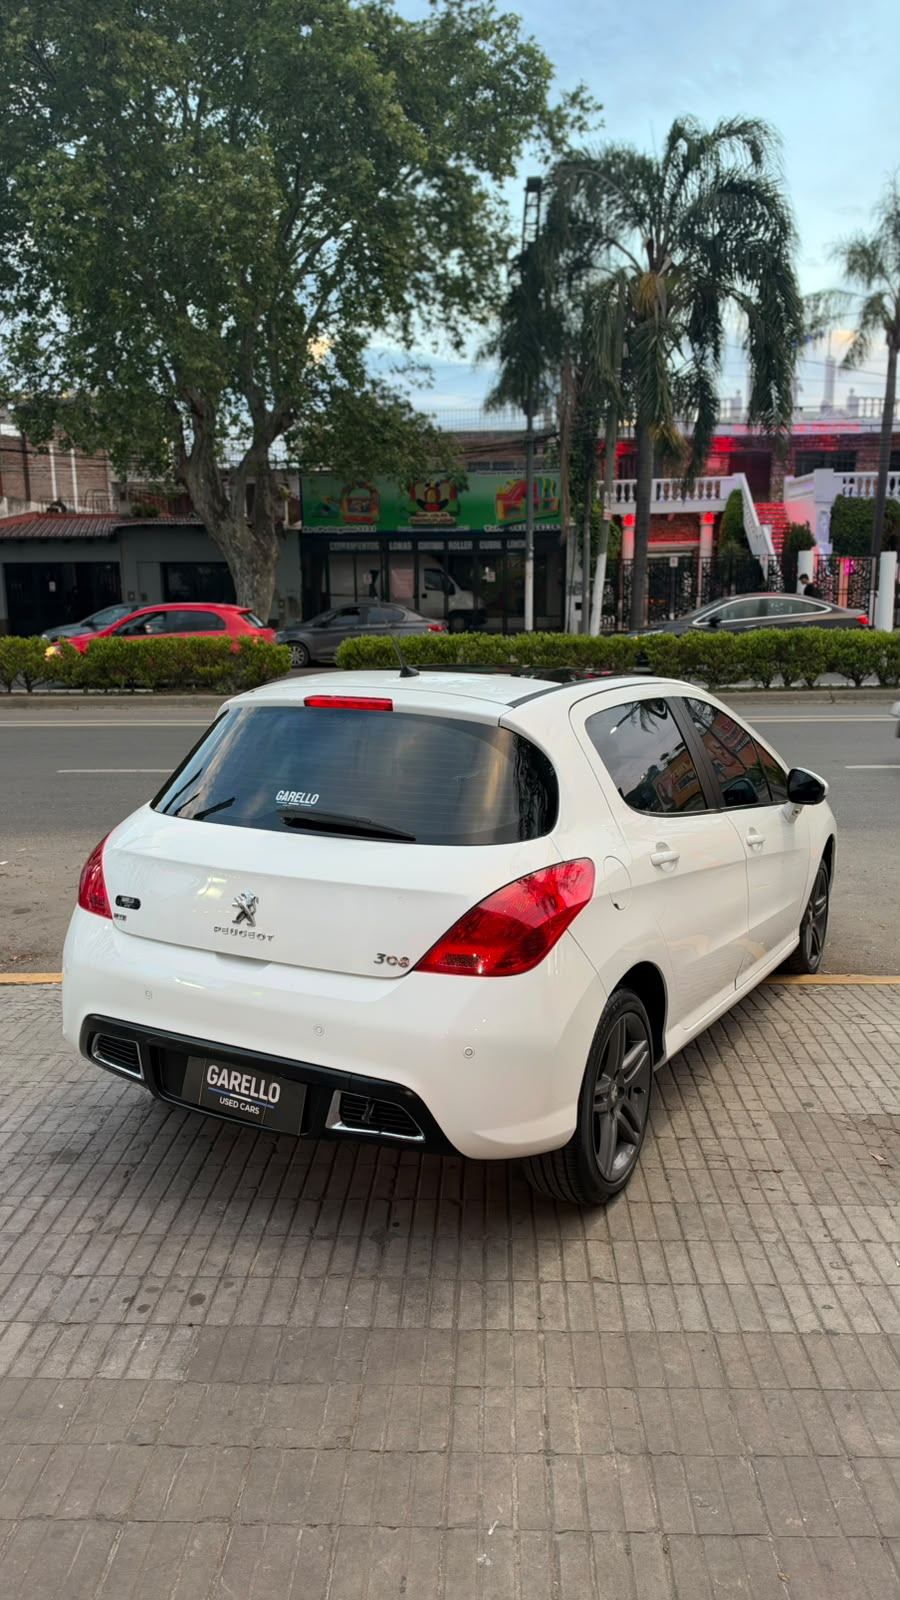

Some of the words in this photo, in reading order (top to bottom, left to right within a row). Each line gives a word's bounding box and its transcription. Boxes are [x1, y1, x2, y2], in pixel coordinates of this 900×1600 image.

[275, 790, 320, 805] GARELLO
[213, 926, 275, 942] PEUGEOT
[373, 952, 410, 968] 308
[206, 1064, 281, 1103] GARELLO
[219, 1096, 239, 1109] USED
[239, 1102, 260, 1115] CARS
